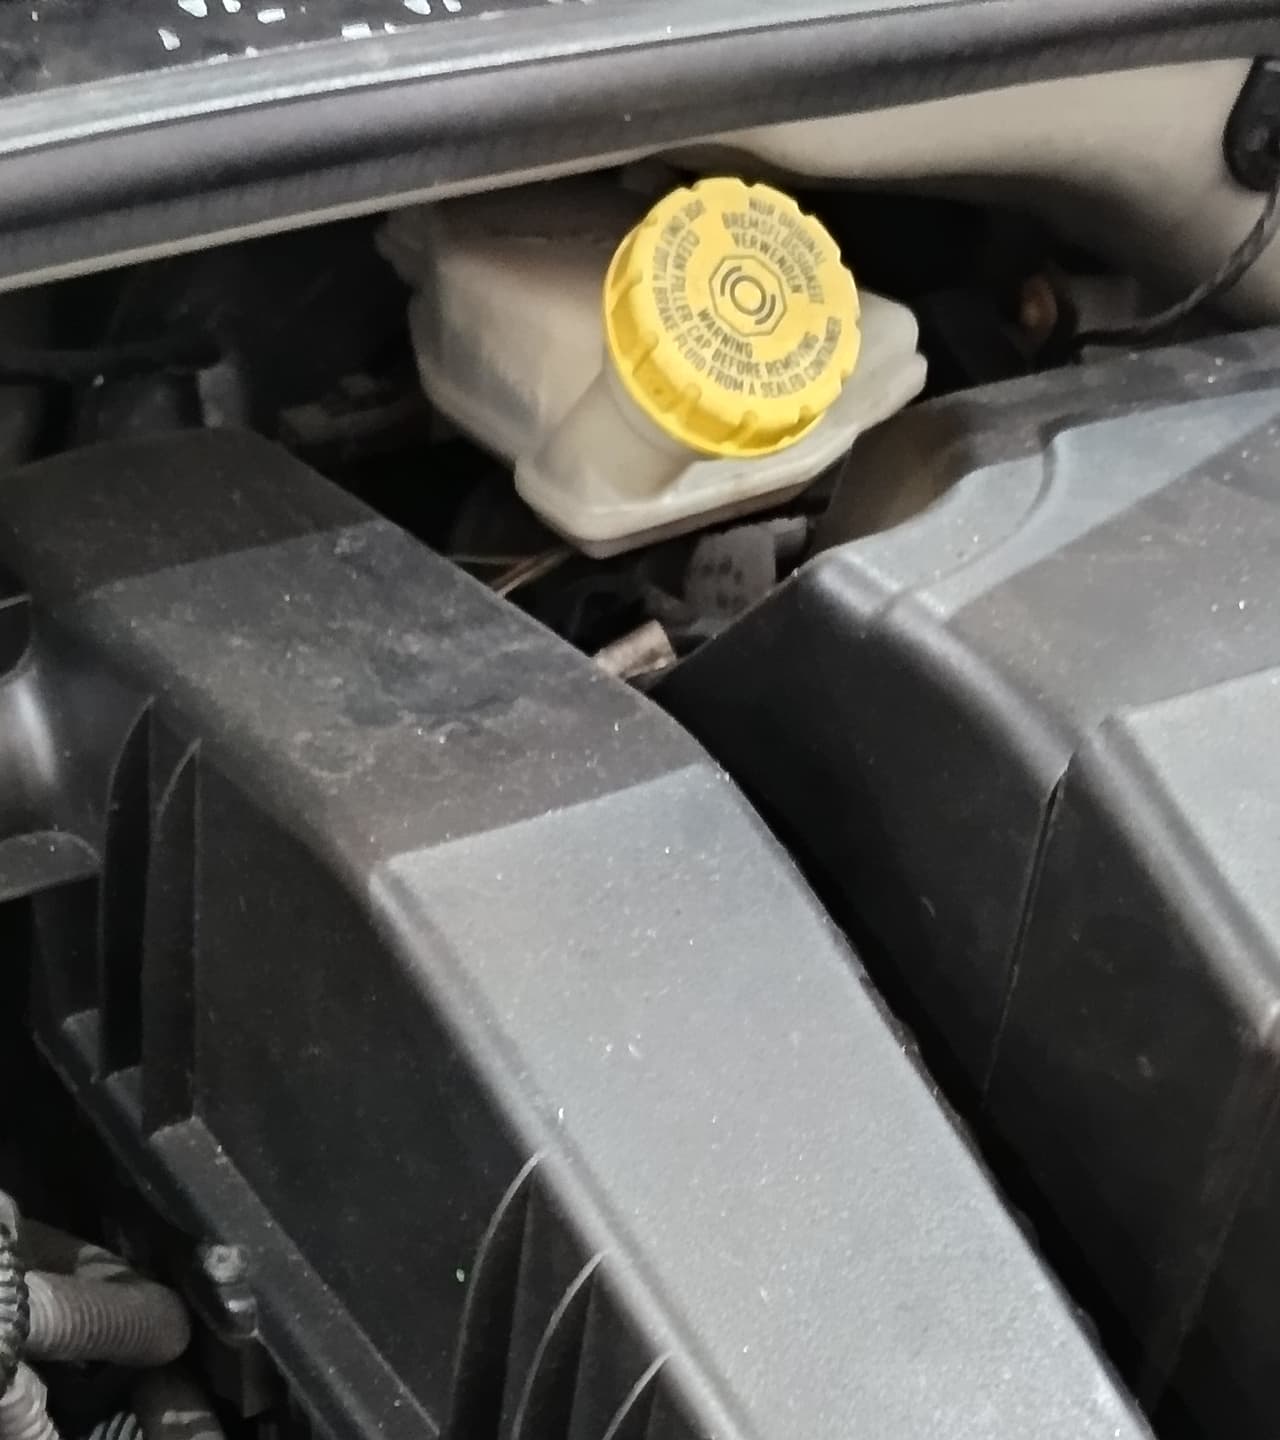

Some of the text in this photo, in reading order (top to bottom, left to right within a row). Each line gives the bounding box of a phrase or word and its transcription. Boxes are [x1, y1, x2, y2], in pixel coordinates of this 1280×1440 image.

[731, 231, 804, 294] VERWENDEN
[687, 324, 713, 350] CAP
[711, 346, 761, 380] BEFORE
[697, 307, 752, 360] WARNING
[706, 365, 744, 393] FROM
[748, 380, 757, 396] A
